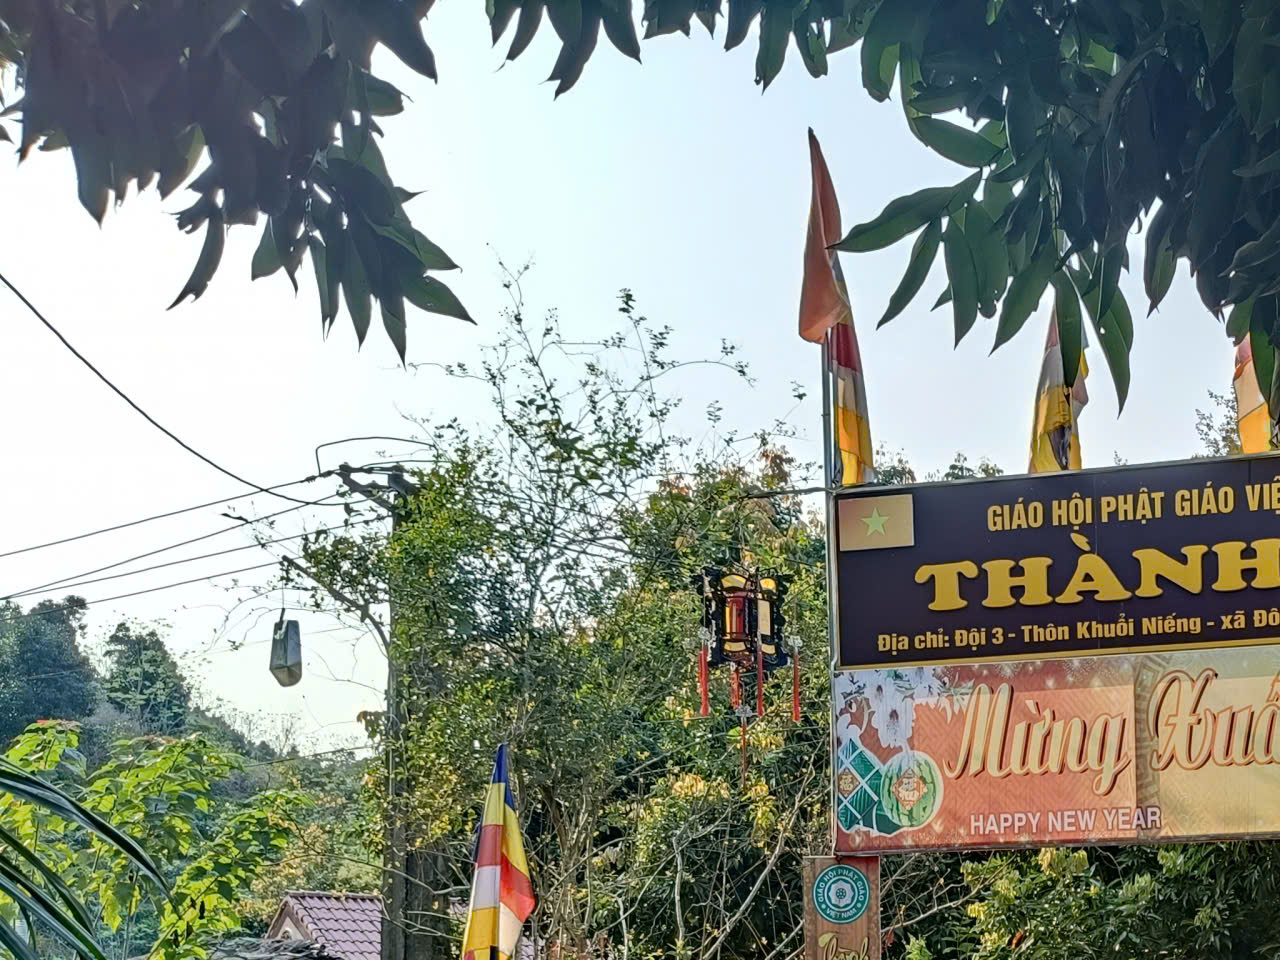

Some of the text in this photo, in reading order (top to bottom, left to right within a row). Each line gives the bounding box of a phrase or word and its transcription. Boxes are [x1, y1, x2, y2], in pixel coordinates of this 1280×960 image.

[987, 498, 1044, 531] GIÁO
[1052, 492, 1092, 531] HỘI
[1102, 488, 1165, 525] PHẬT
[1175, 481, 1234, 517] GIÁO
[878, 633, 909, 657] Địa
[914, 627, 949, 651] chỉ:
[955, 628, 987, 651] Đội
[992, 627, 1004, 645] 3
[1021, 622, 1069, 643] Thôn
[1076, 613, 1134, 640] Khuổi
[1221, 612, 1245, 631] xã
[944, 683, 1132, 797] Mừng
[970, 805, 1162, 836] HAPPY NEW YEAR
